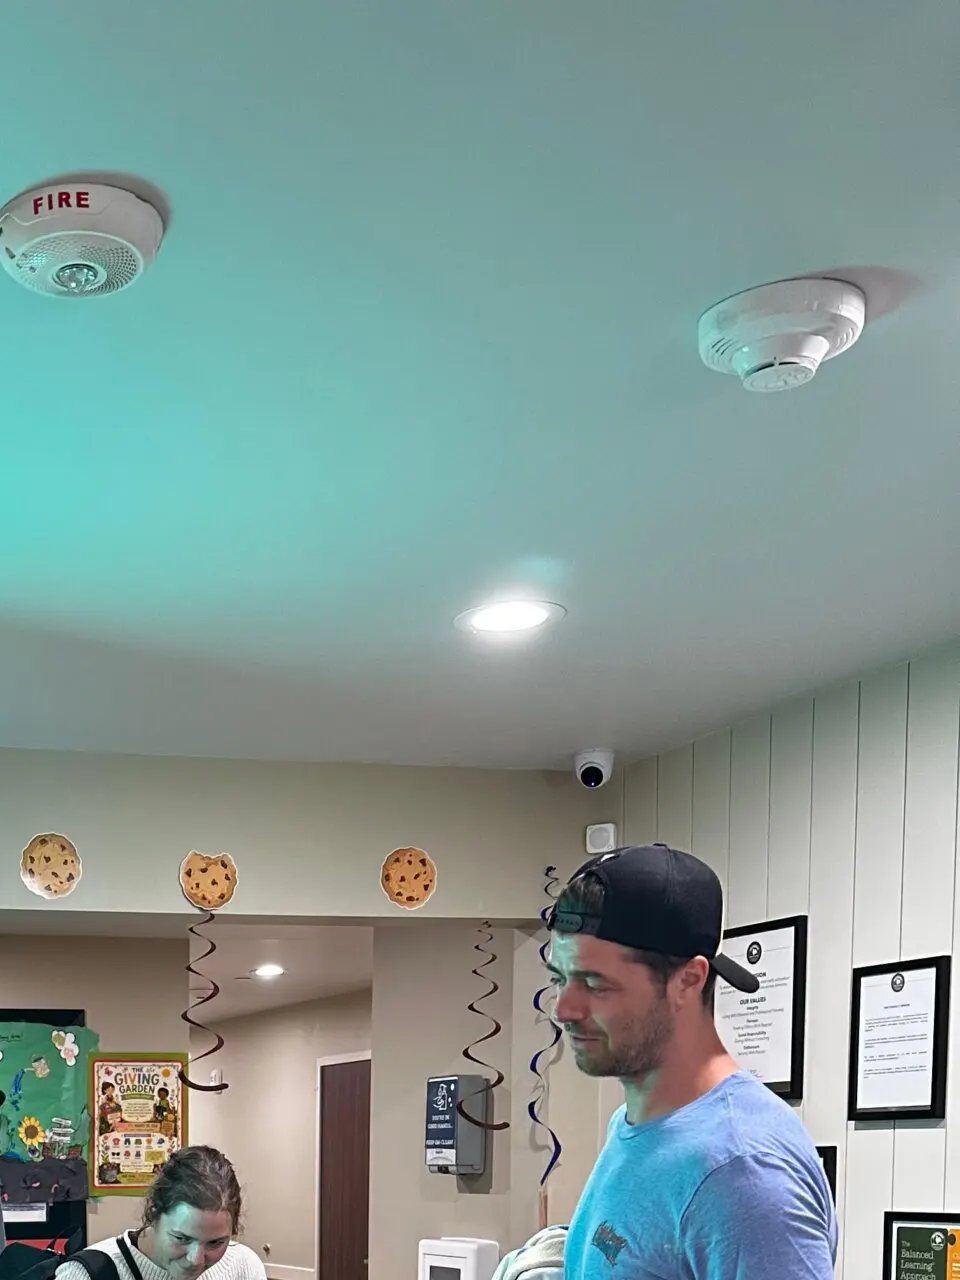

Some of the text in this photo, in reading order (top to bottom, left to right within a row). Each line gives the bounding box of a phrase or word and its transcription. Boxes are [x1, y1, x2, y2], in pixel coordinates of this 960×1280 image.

[32, 192, 90, 215] FIRE
[114, 1073, 160, 1085] GIVING
[120, 1085, 155, 1094] GARDEN
[901, 1249, 934, 1259] Balanced
[901, 1272, 936, 1280] Approach
